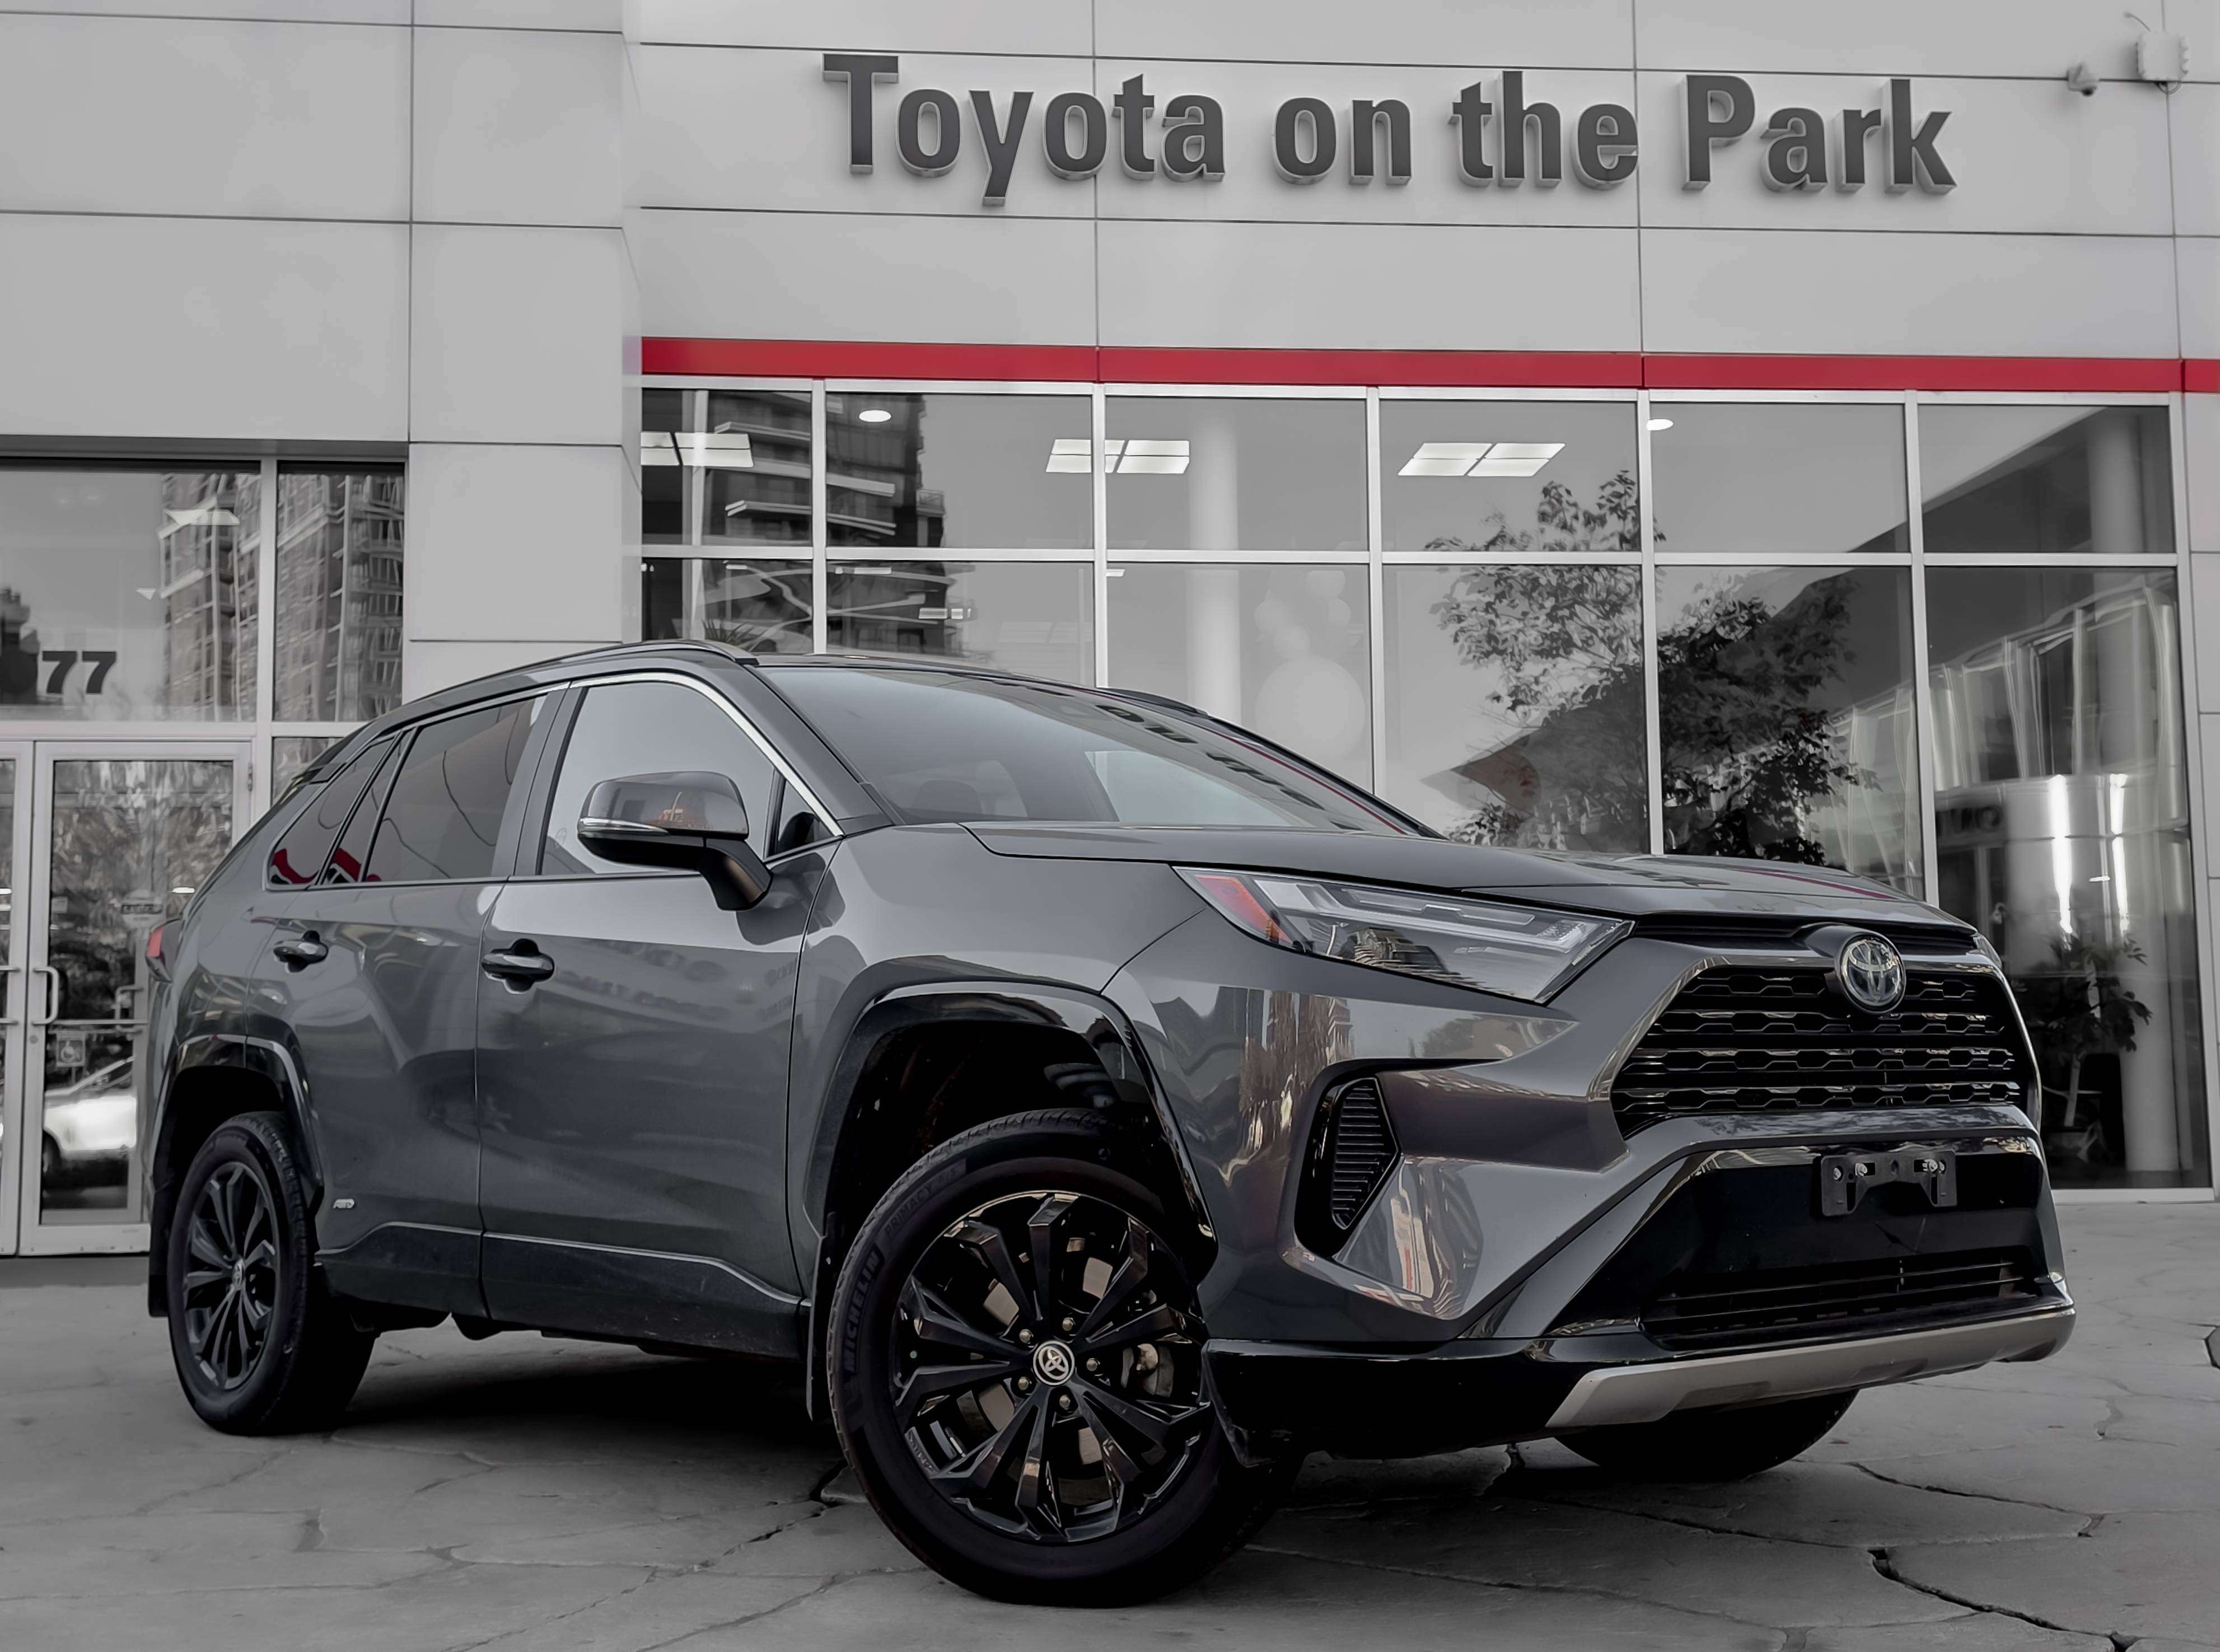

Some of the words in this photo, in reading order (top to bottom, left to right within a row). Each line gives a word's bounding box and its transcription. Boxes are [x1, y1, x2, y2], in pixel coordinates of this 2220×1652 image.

[822, 53, 1225, 206] Toyota
[1272, 96, 1411, 186] on
[1448, 71, 1639, 189] the
[1679, 74, 1957, 194] Park
[843, 1246, 881, 1374] MICHELIN
[884, 1183, 934, 1237] PRIMACY
